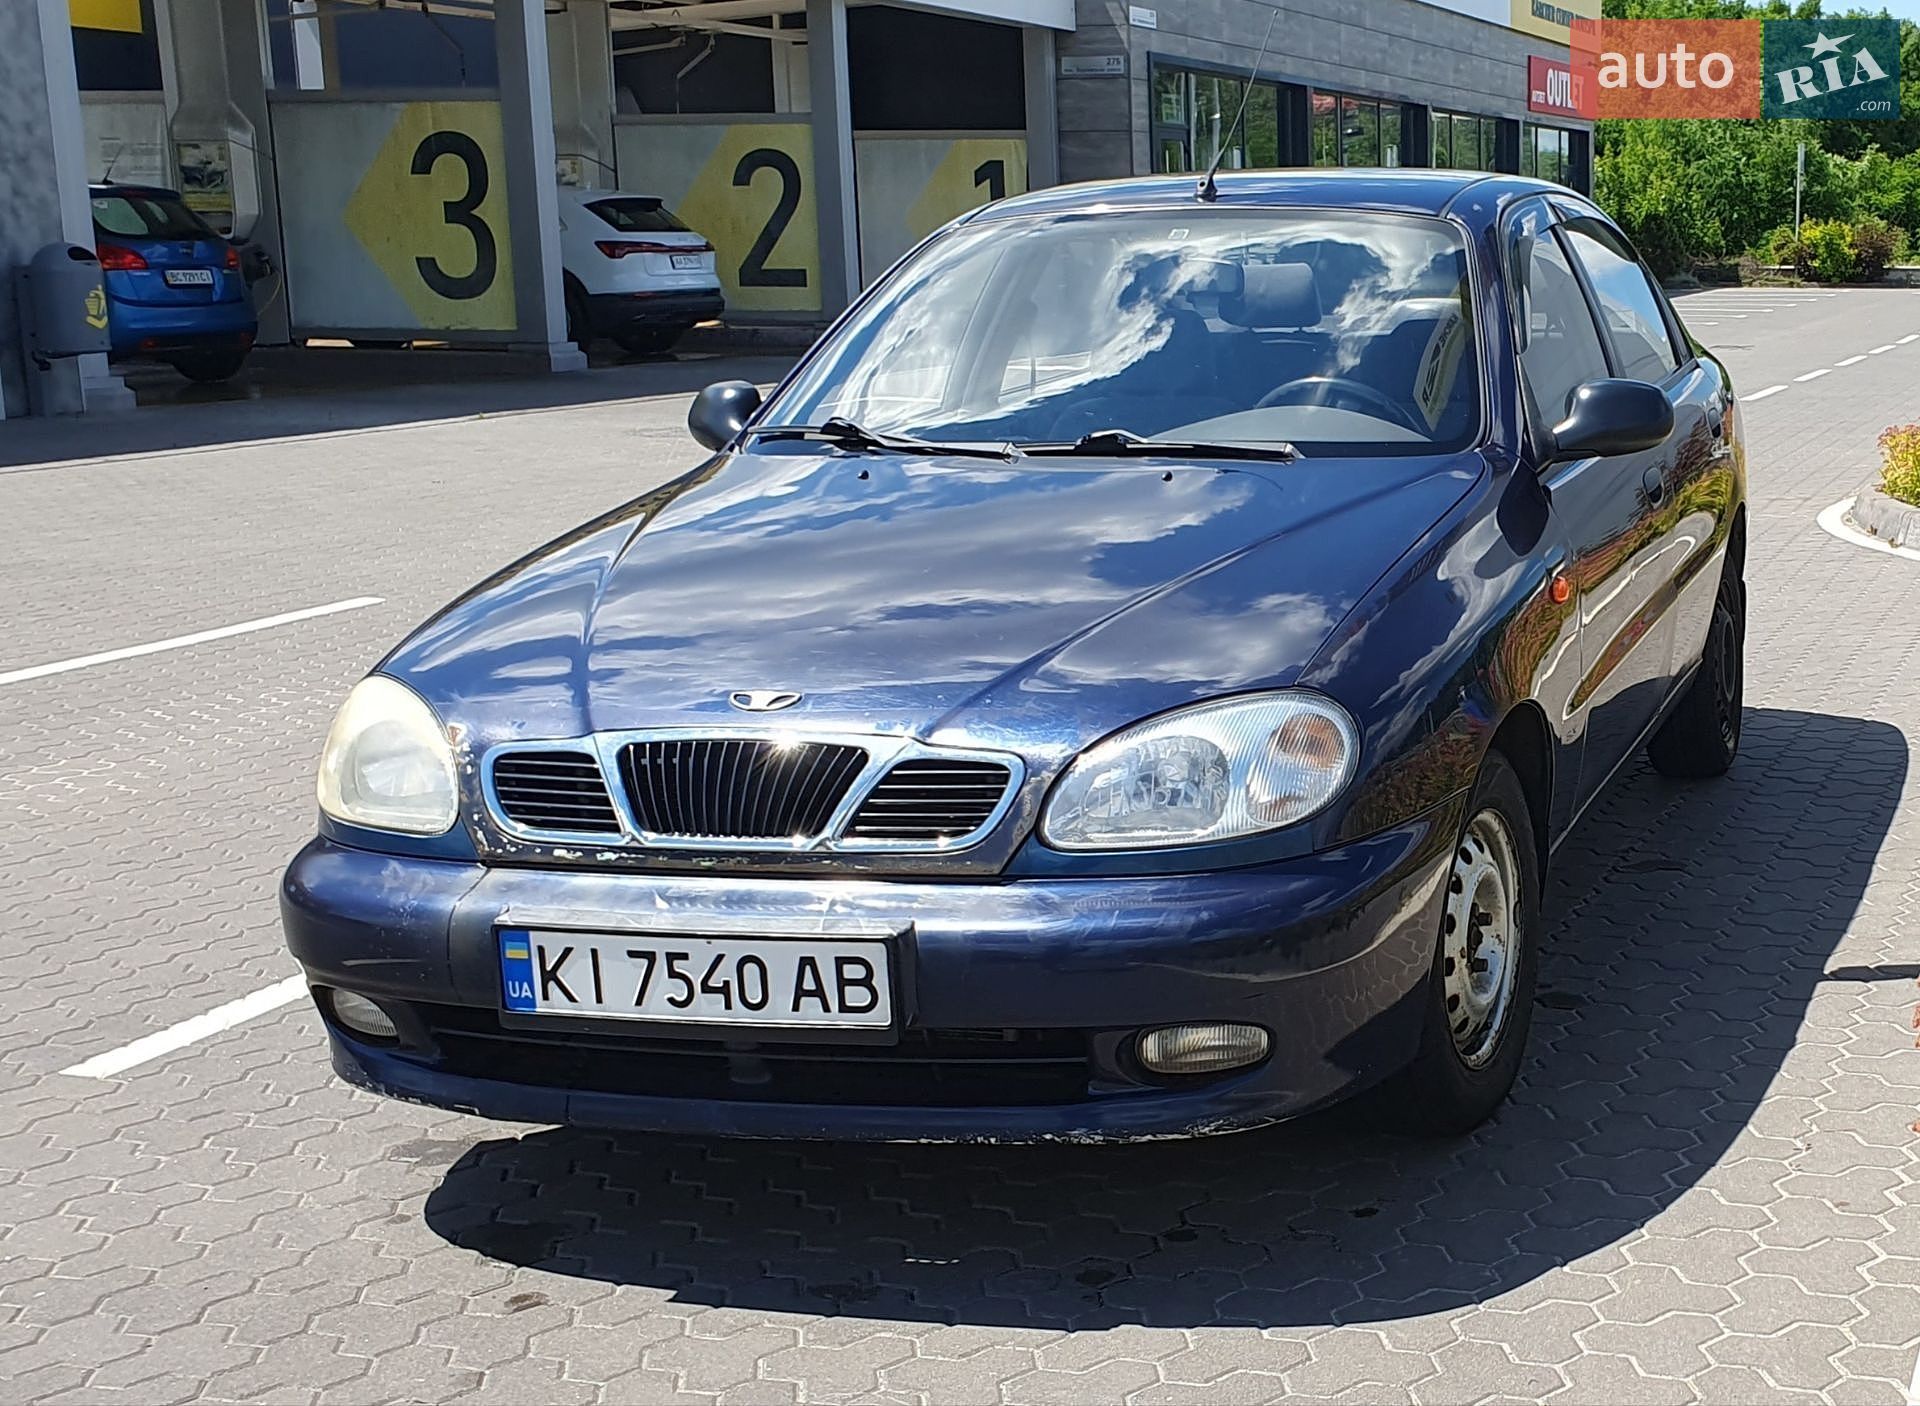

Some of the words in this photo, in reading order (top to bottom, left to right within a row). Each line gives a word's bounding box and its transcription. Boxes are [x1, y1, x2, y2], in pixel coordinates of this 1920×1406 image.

[1546, 68, 1584, 111] OUTLET
[411, 130, 497, 300] 3
[732, 148, 808, 288] 2
[508, 979, 533, 999] UA
[536, 944, 604, 1005] KI
[626, 949, 769, 1012] 7540
[791, 955, 880, 1015] AB
